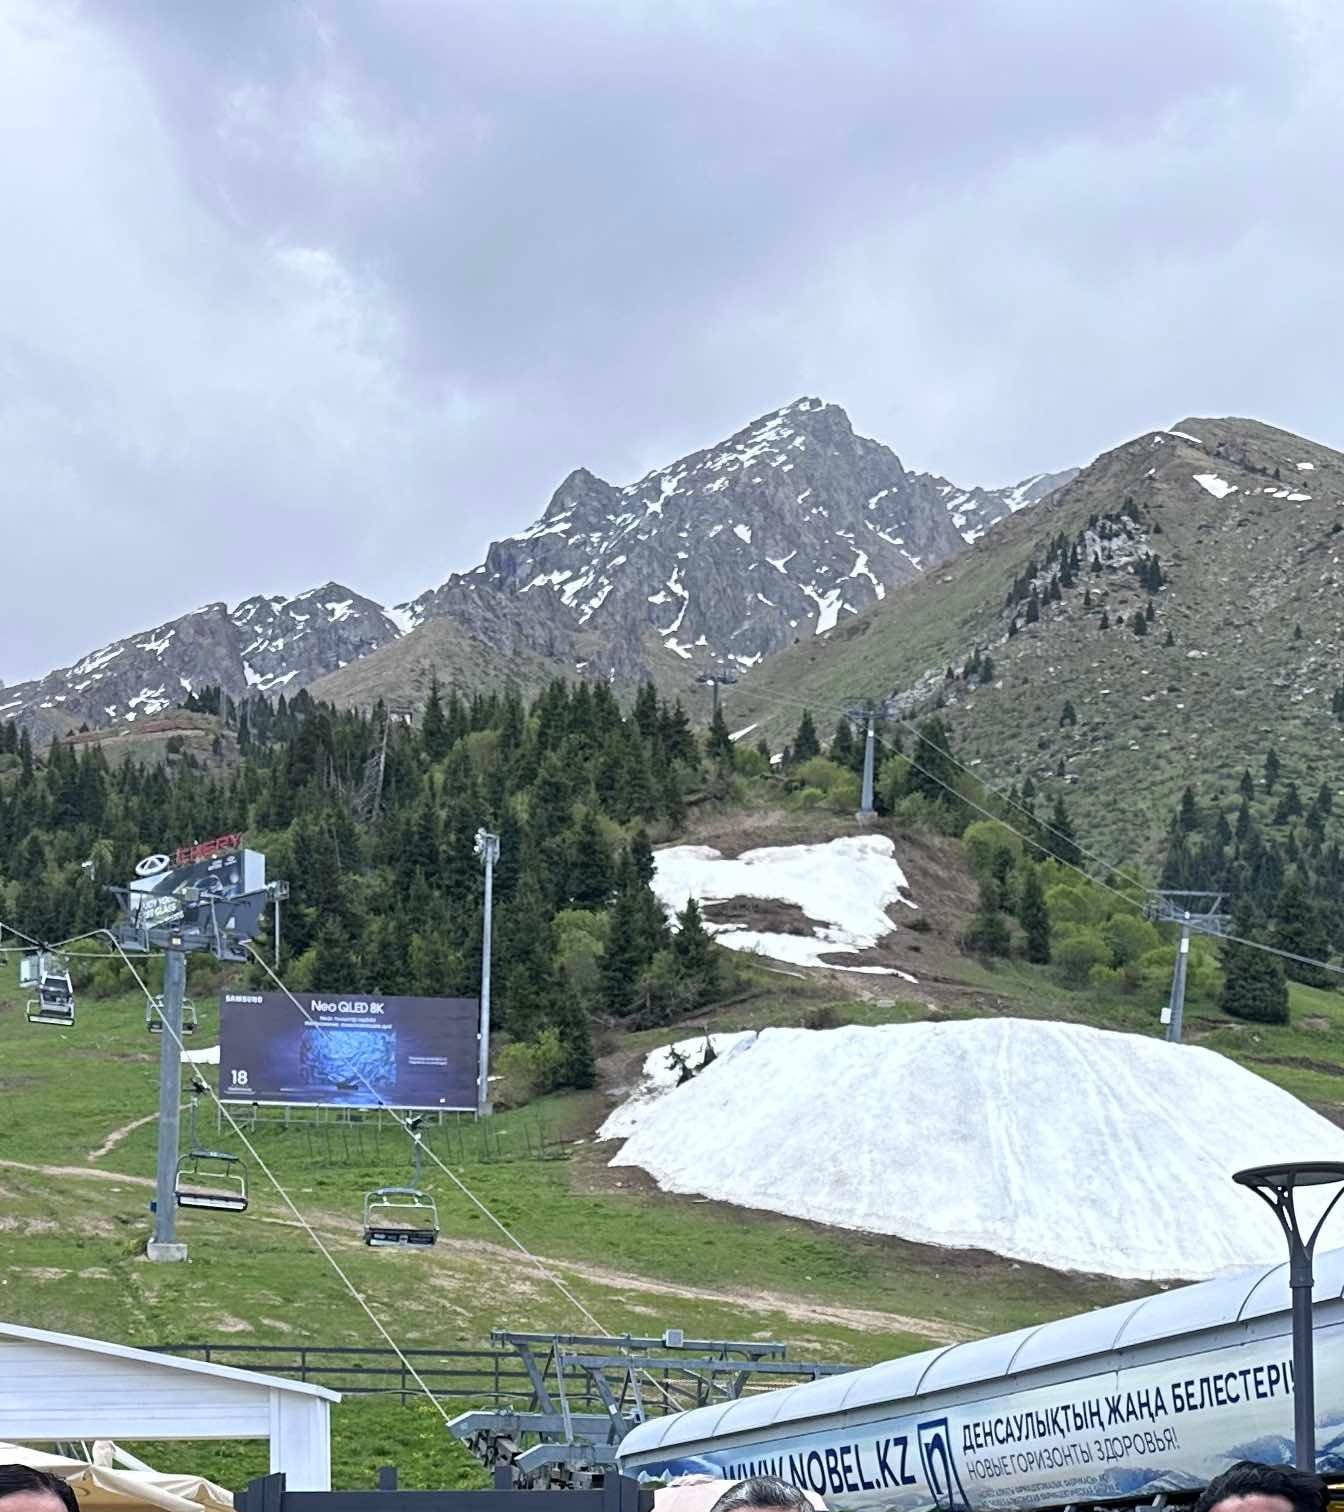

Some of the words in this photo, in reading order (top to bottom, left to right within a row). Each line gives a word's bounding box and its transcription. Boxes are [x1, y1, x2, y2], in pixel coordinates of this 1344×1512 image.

[311, 1000, 337, 1013] Neo
[338, 1001, 368, 1014] QLED
[370, 1003, 384, 1014] 8K
[231, 1070, 248, 1085] 18
[962, 1399, 1106, 1455] ДЕНСАУЛЫҚТЫҢ
[1106, 1386, 1169, 1425] ЖАҢА
[722, 1436, 917, 1497] WNOBEL.KZ
[967, 1455, 1009, 1480] НОВЫЕ
[1009, 1440, 1093, 1475] ГОРИЗОНТЫ
[1094, 1427, 1181, 1462] ЗДОРОВЬЯ!
